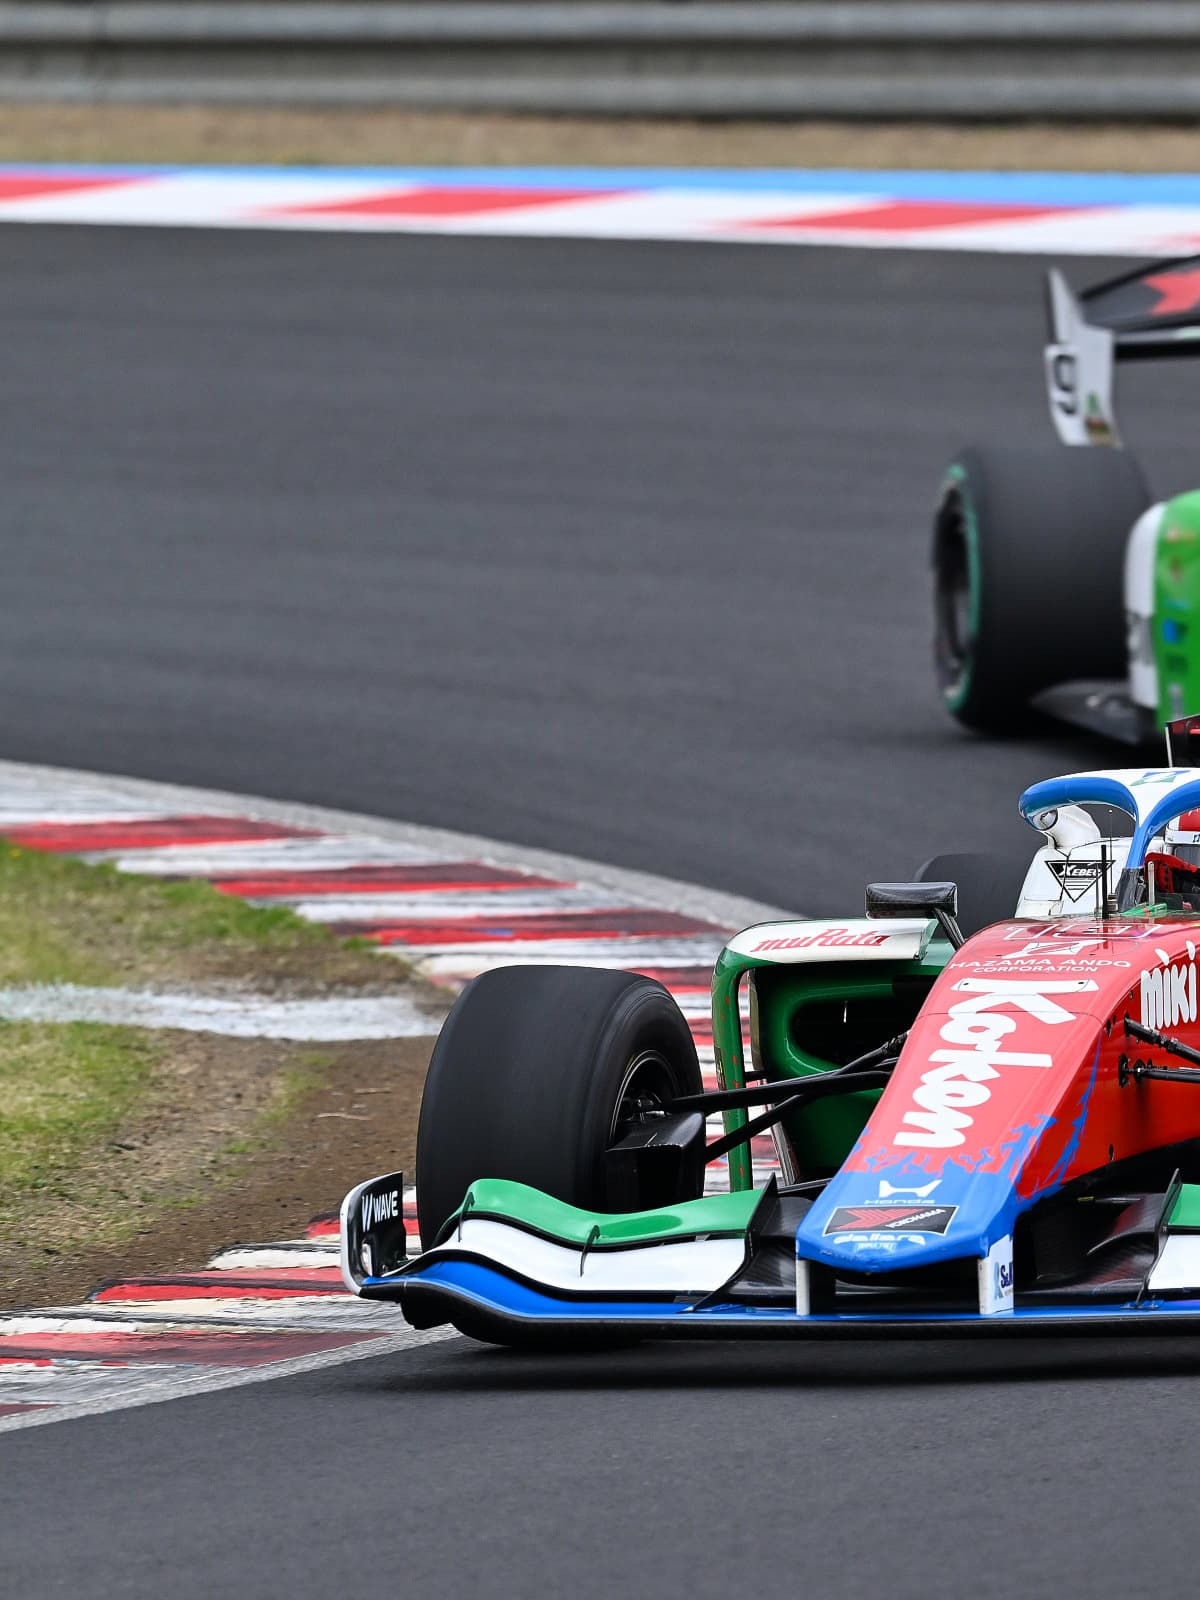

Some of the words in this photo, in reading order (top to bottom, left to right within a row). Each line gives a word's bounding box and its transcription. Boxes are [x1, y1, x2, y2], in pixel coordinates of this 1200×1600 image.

[948, 957, 1050, 969] HAZAMA
[1064, 958, 1132, 969] ANDO
[973, 964, 1100, 973] CORPORATION
